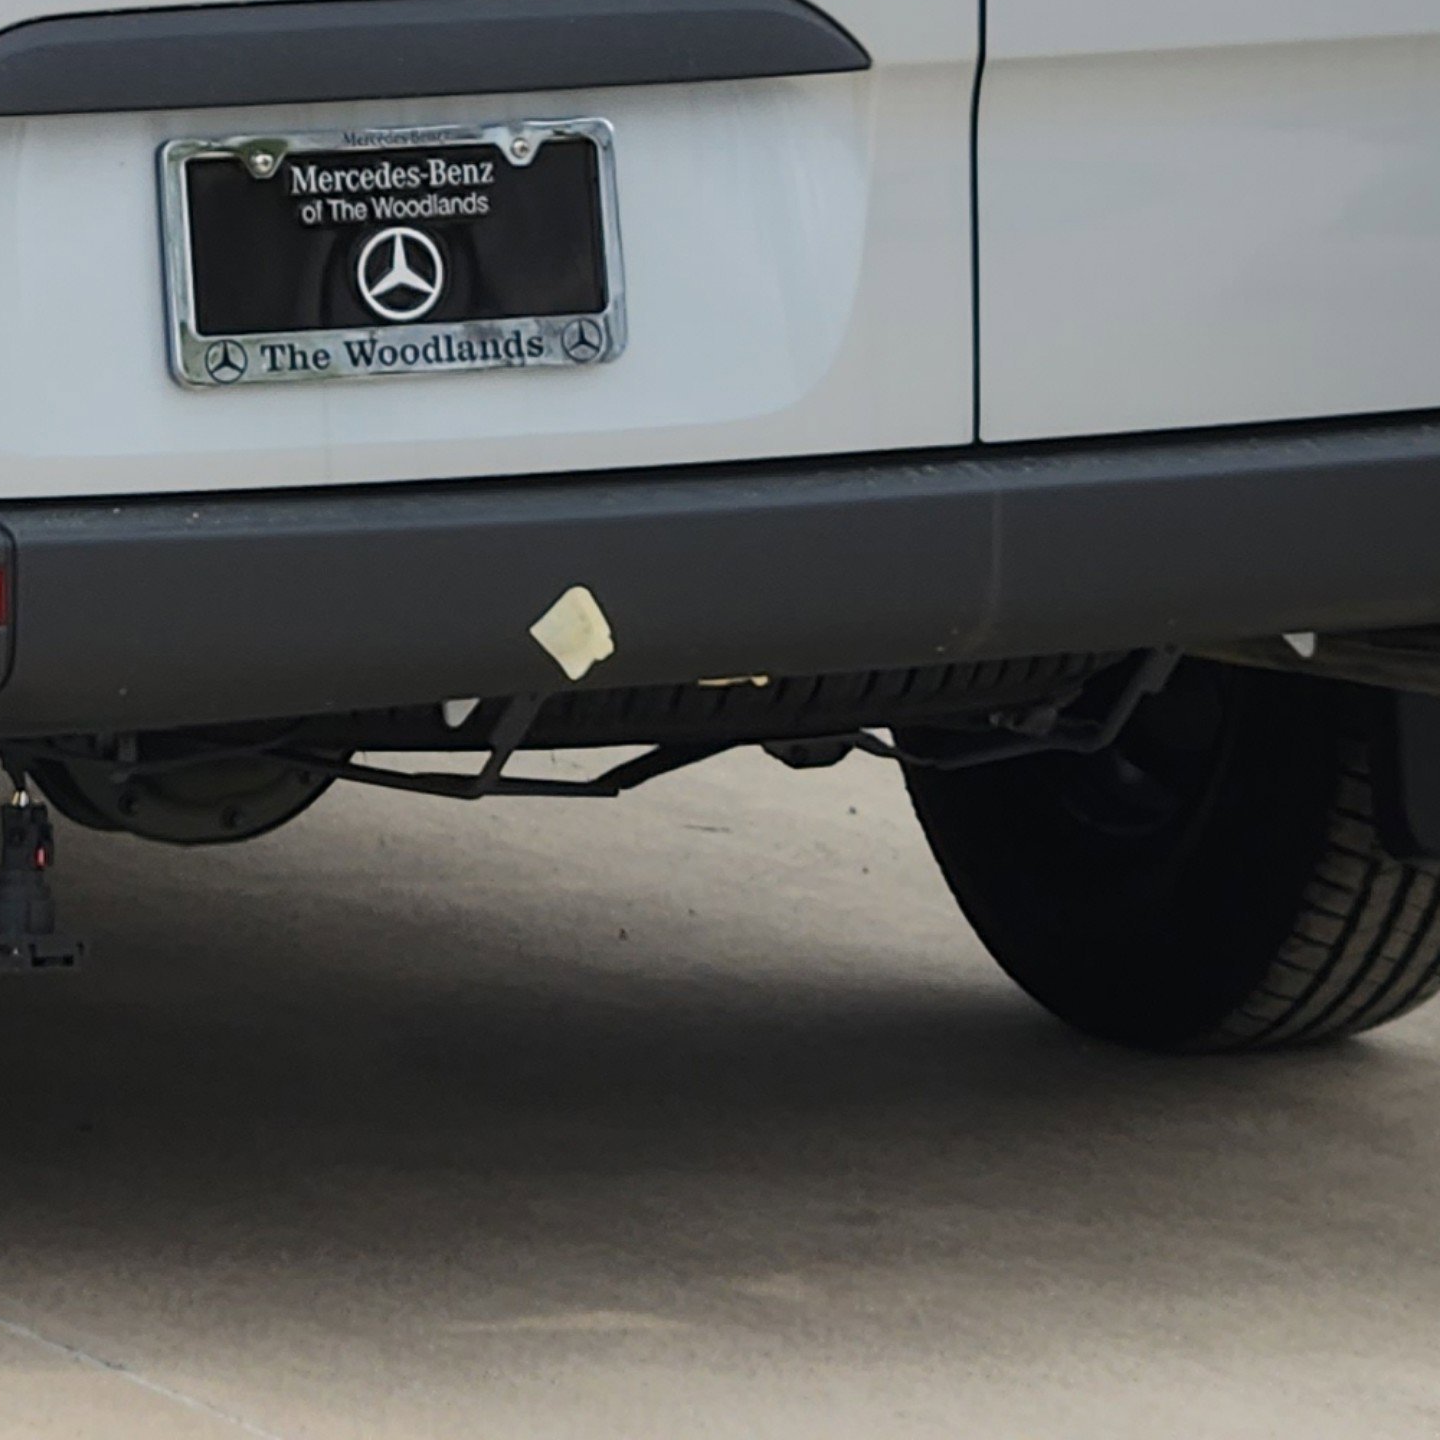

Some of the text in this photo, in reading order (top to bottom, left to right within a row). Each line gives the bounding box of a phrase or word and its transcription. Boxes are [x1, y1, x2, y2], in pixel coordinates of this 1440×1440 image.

[290, 159, 494, 195] Mercedes-Benz
[302, 192, 489, 224] of The Woodlands
[260, 331, 545, 372] The Woodlands
